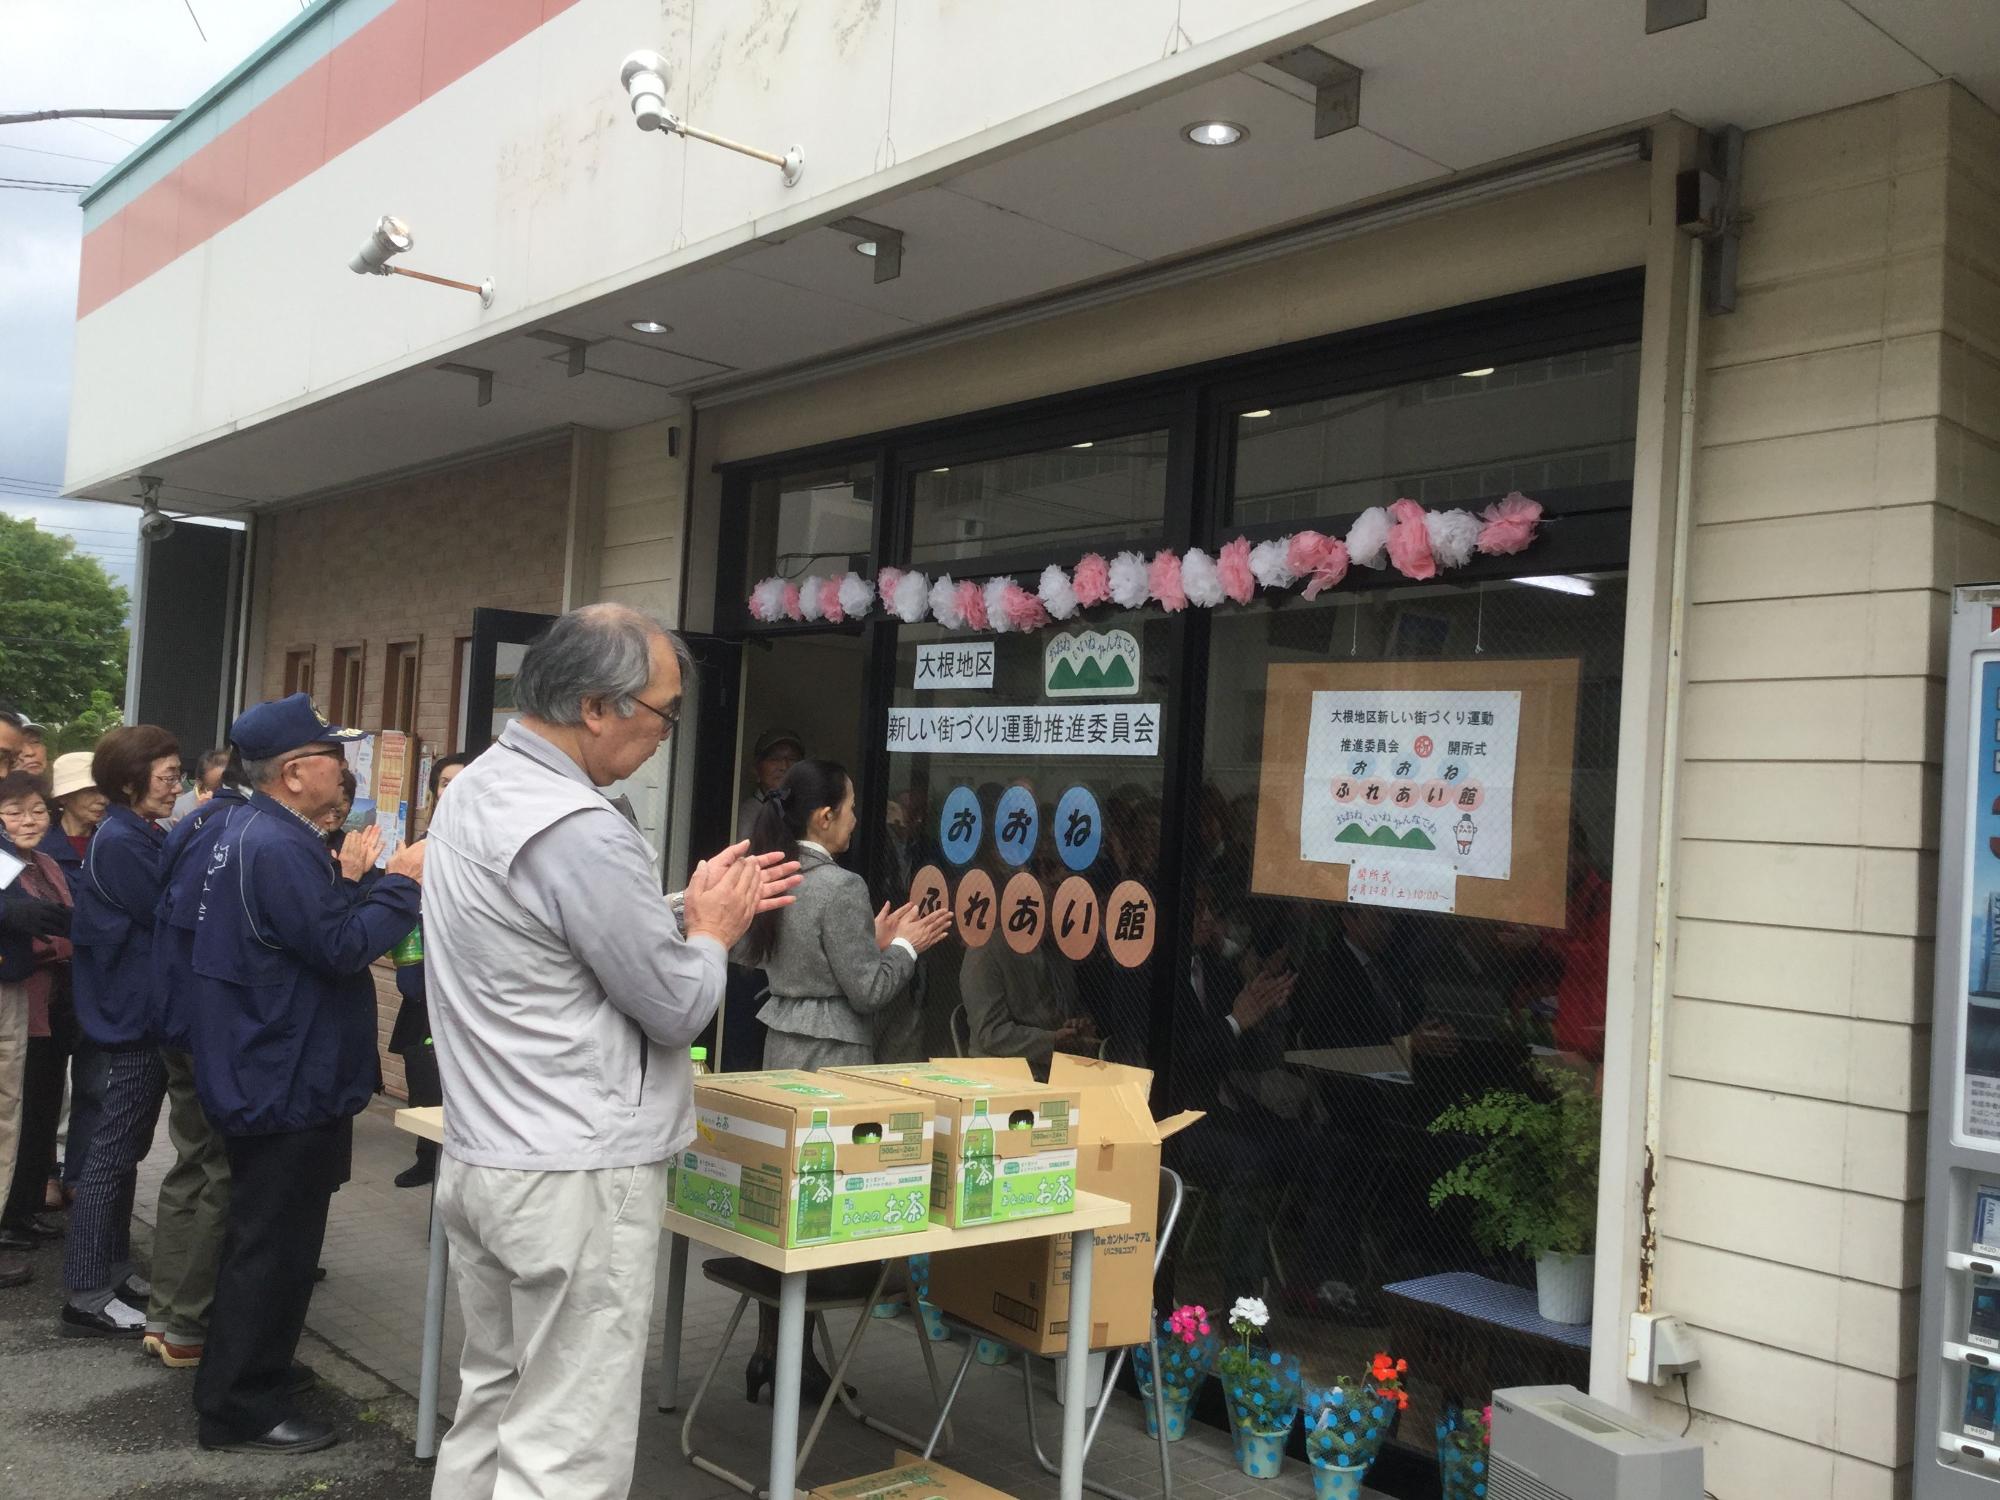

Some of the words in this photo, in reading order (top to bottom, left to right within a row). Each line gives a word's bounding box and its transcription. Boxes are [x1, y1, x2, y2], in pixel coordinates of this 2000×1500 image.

[918, 651, 993, 679] 大根地区
[888, 711, 1155, 745] 新しい街づくり運動推進委員会
[1331, 709, 1494, 727] 大根地区新しい街づくり運動
[1340, 738, 1400, 754] 推進委員会
[1447, 740, 1487, 756] 開所式
[1336, 783, 1478, 805] ふれあい館
[948, 808, 1092, 848] おおね
